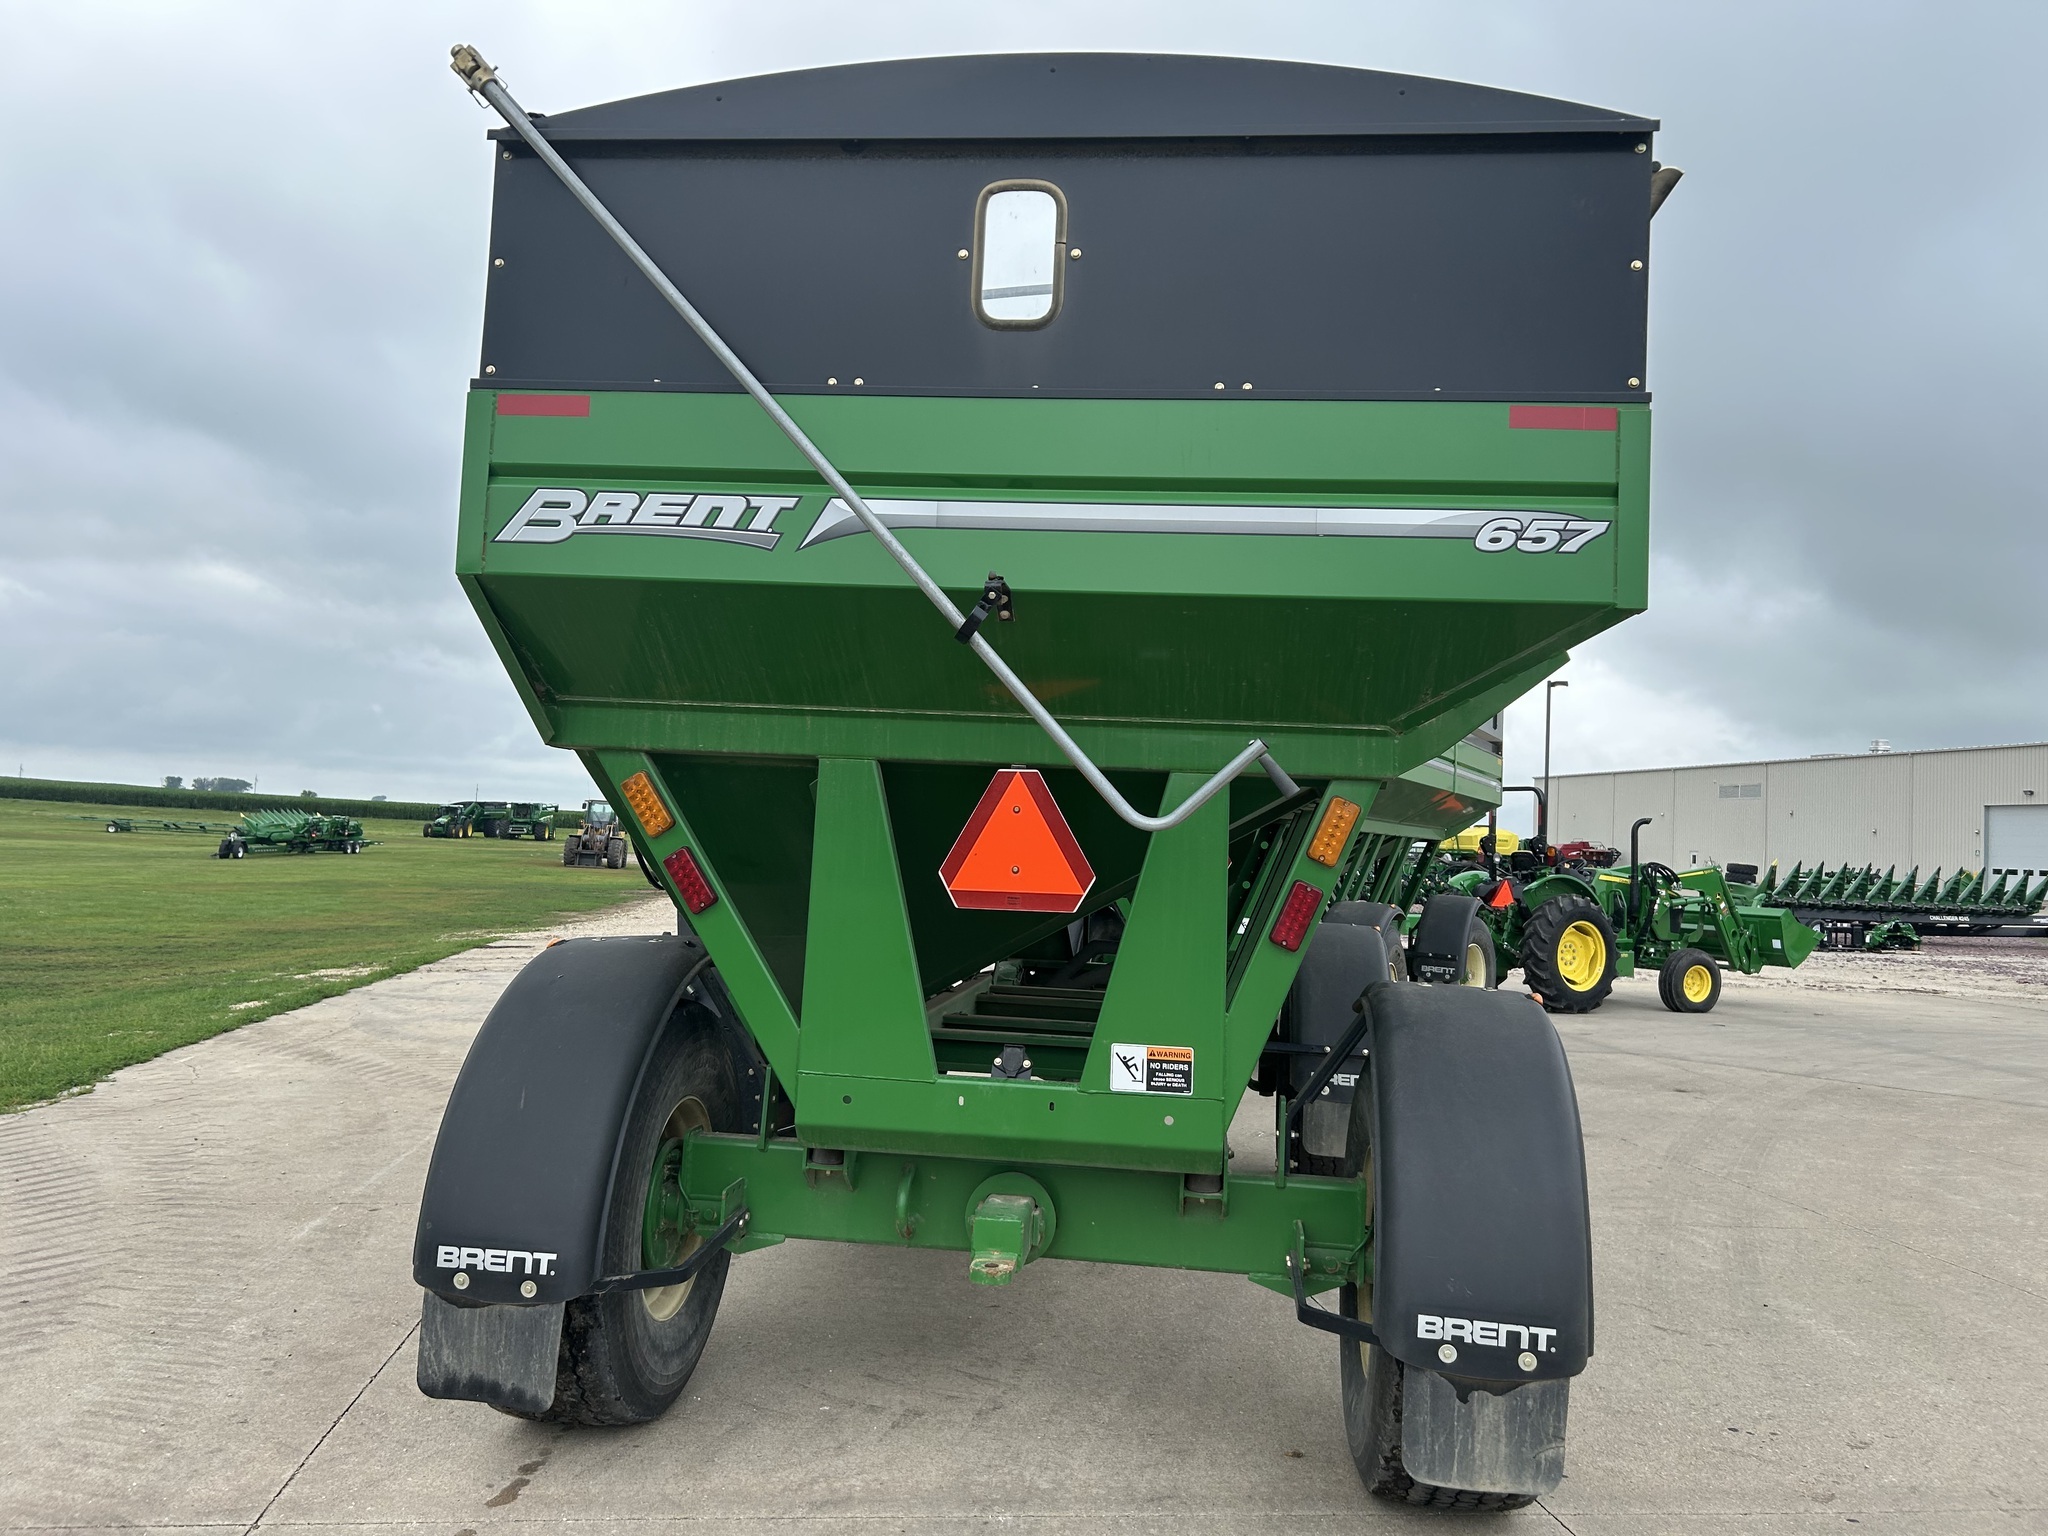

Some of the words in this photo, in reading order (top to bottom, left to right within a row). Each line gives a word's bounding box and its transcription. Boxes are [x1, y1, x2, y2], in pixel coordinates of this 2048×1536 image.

[491, 487, 803, 545] BRENT
[1474, 517, 1612, 553] 657
[1156, 1051, 1191, 1059] WARNING
